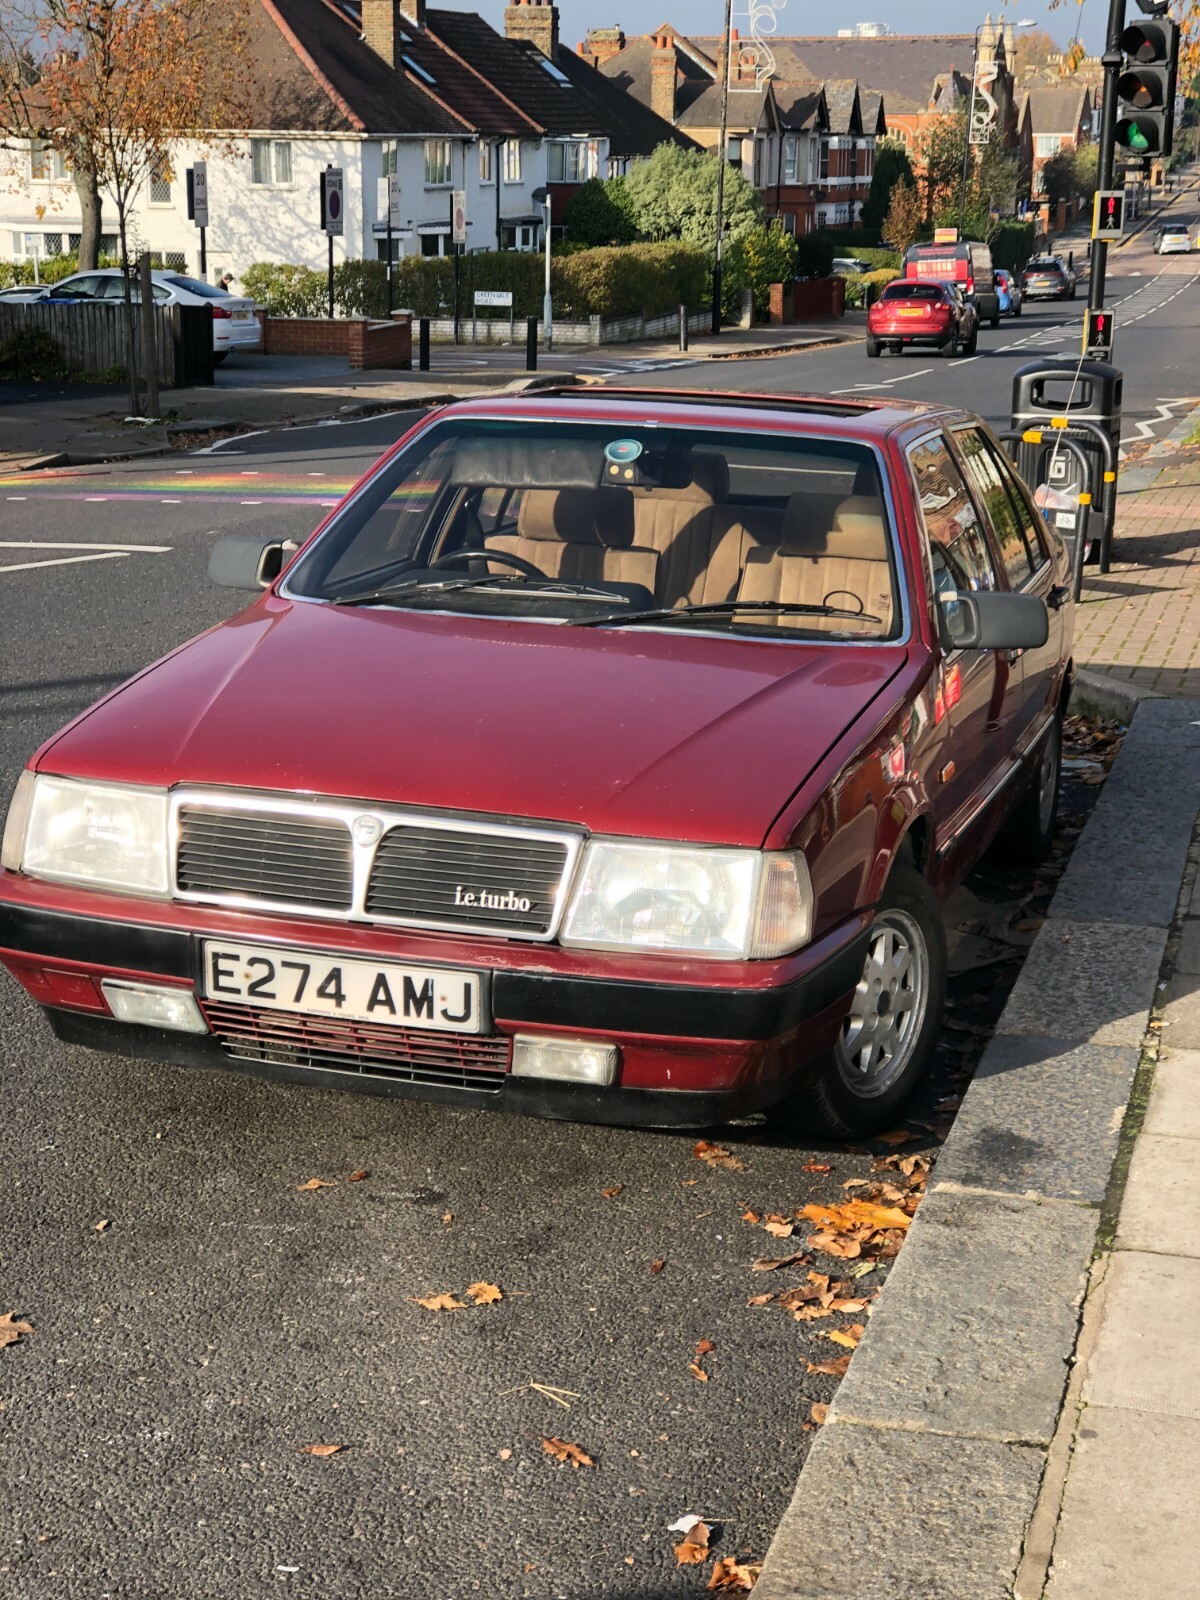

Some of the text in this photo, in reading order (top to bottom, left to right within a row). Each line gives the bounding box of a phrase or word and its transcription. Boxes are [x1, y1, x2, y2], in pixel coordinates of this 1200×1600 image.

[196, 172, 205, 186] 20
[211, 951, 472, 1023] E274 AMJ
